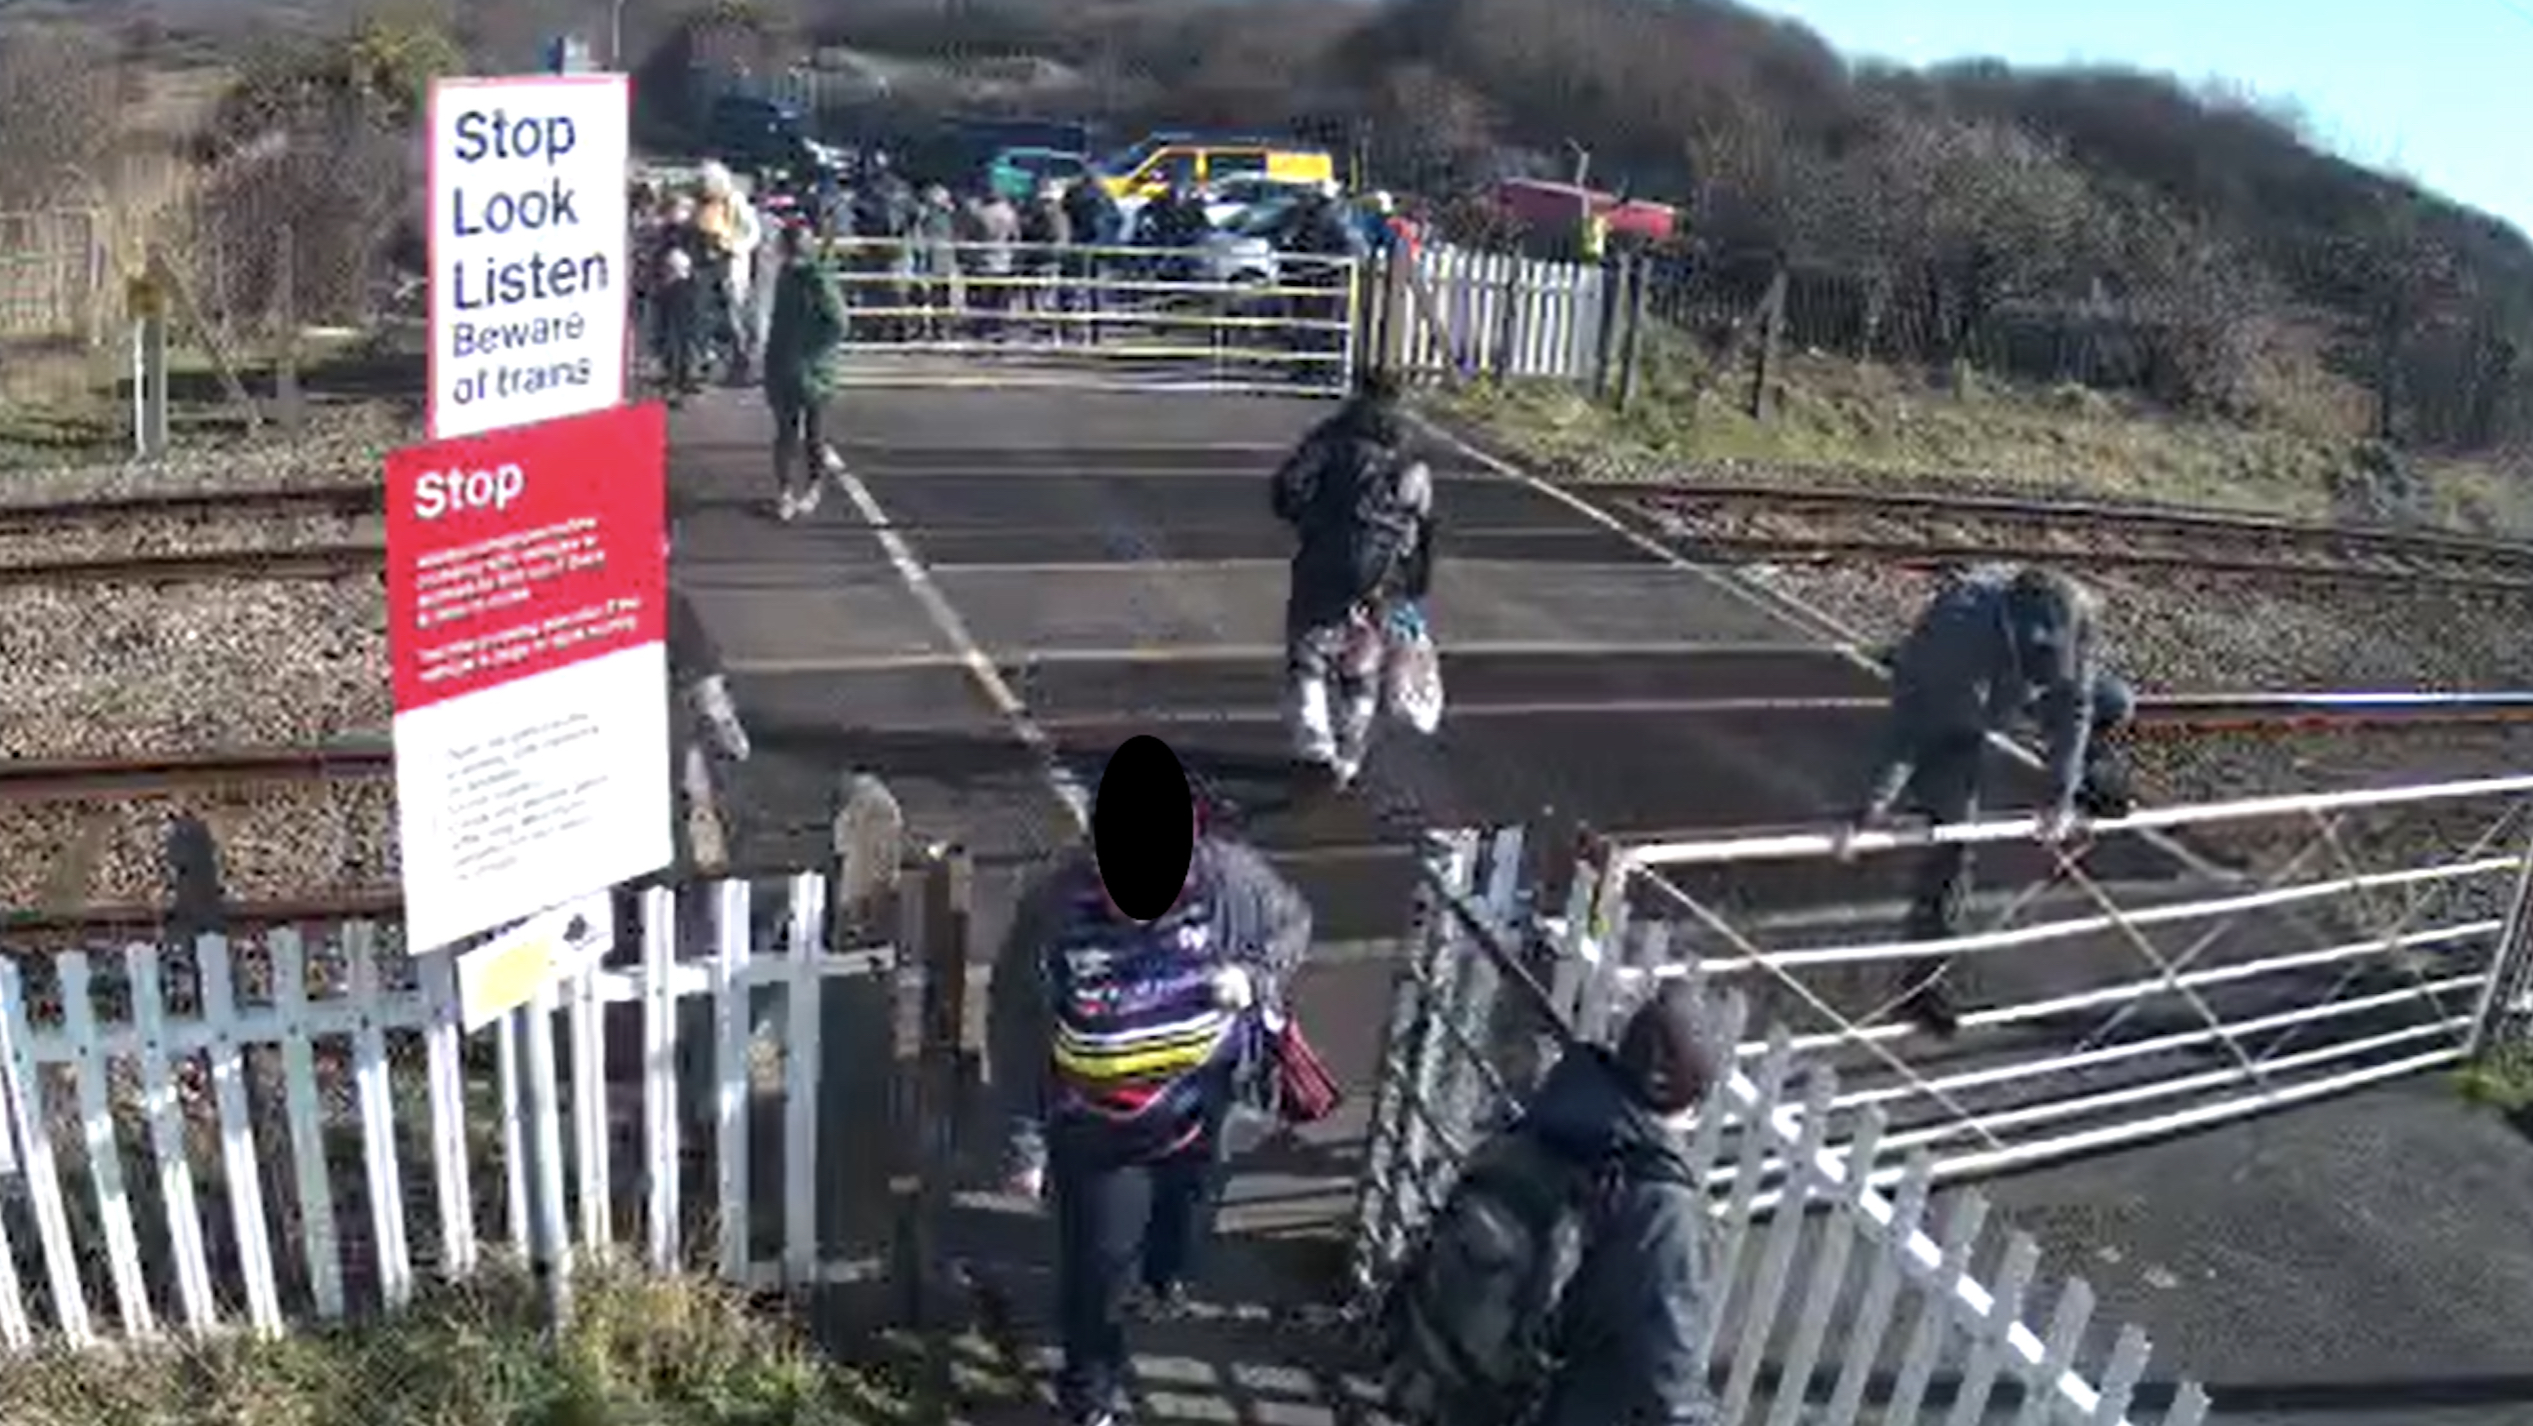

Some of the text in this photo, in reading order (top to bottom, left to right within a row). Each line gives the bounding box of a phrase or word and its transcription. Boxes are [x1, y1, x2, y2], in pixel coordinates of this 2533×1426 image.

[455, 108, 576, 166] Stop
[453, 176, 579, 237] Look
[454, 251, 609, 310] Listen
[453, 311, 585, 358] Beware
[453, 367, 488, 405] of
[414, 463, 523, 519] Stop
